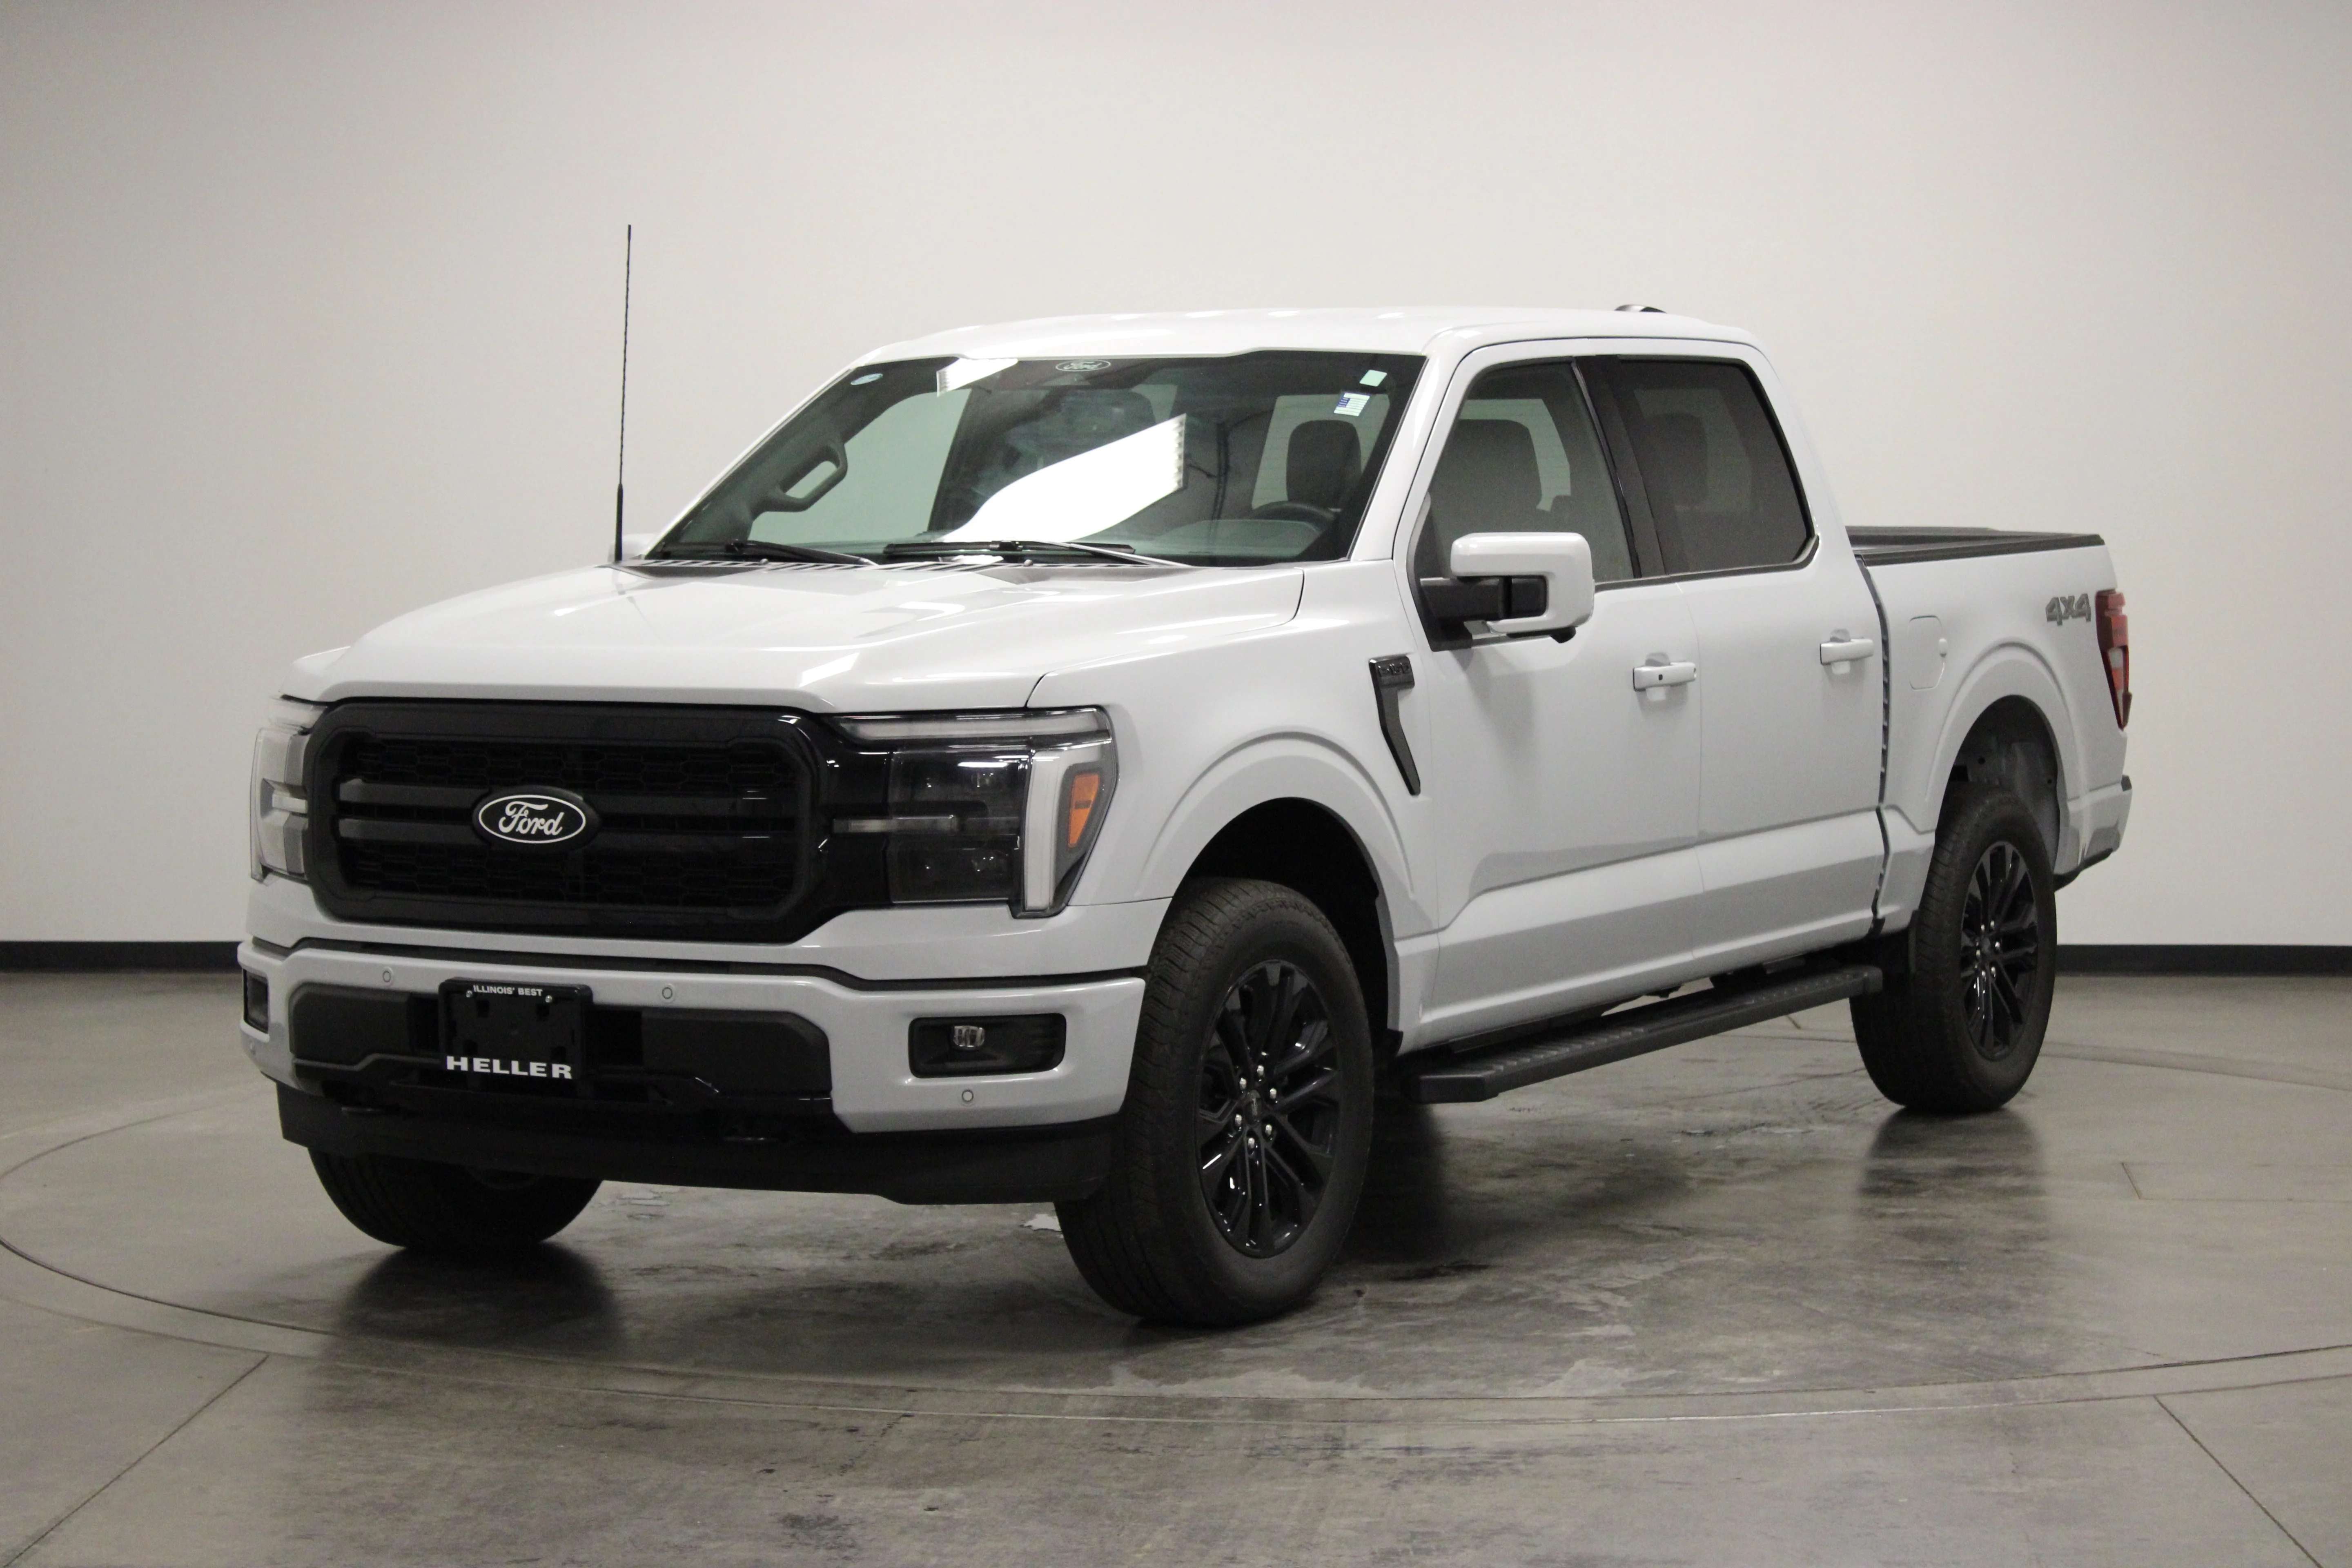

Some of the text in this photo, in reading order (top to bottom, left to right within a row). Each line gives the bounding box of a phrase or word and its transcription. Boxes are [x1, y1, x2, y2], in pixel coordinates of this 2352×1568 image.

[498, 800, 565, 835] Ford
[473, 984, 543, 996] ILLINOIS' BEST
[446, 1055, 572, 1080] HELLER
